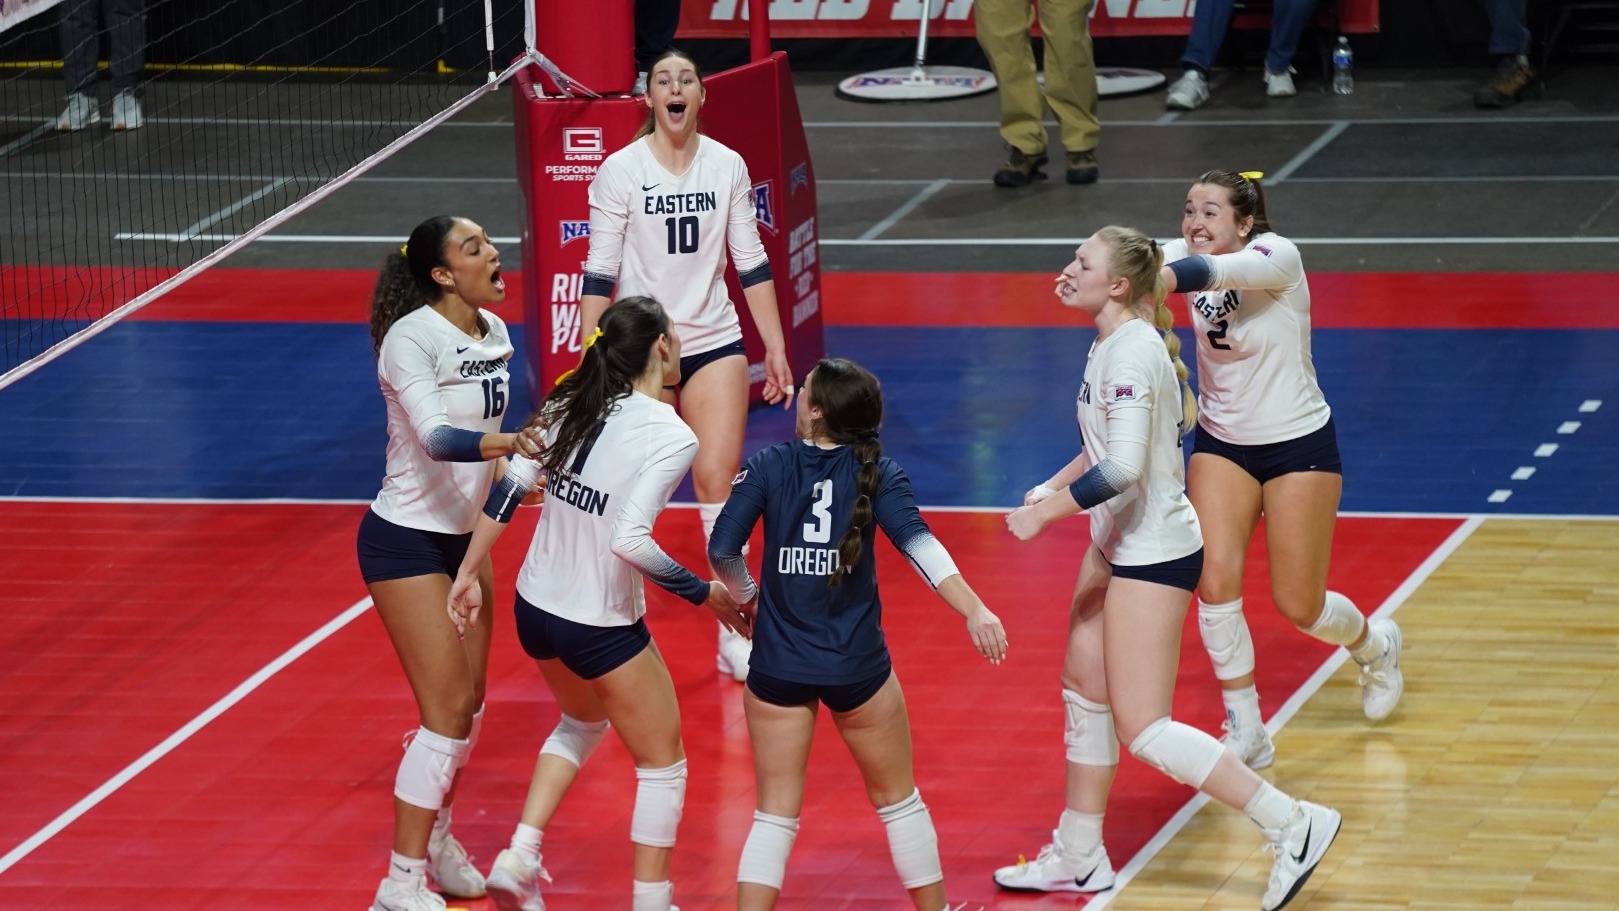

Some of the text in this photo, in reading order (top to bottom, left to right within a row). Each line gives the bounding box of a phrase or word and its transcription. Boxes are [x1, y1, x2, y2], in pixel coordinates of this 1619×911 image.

[545, 165, 598, 174] PERFORM
[644, 191, 717, 215] EASTERN
[562, 222, 590, 242] NA
[665, 215, 699, 255] 10
[1207, 319, 1232, 351] 2
[481, 376, 505, 420] 16
[803, 478, 834, 544] 3
[778, 547, 851, 576] OREGO
